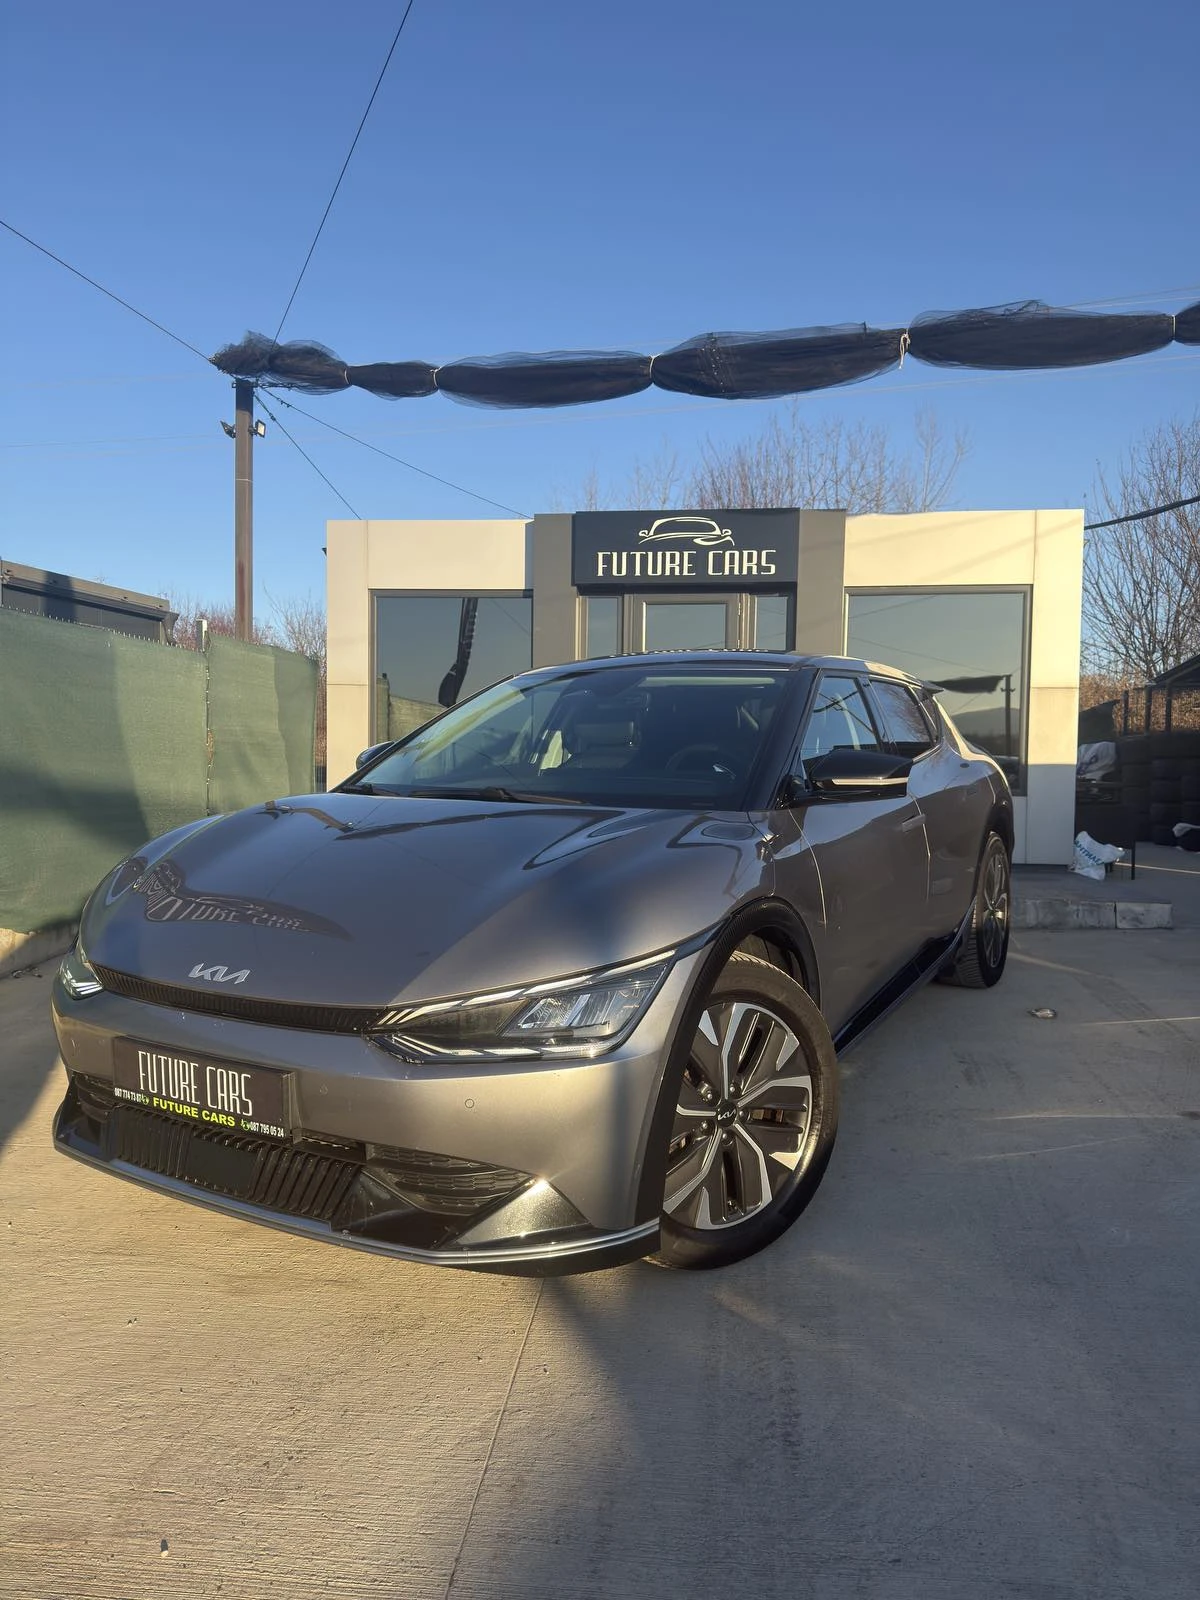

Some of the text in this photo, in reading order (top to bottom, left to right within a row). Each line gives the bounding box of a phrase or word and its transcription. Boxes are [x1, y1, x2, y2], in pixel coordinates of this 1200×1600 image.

[597, 549, 776, 577] FUTURE CARS
[137, 1050, 253, 1116] FUTURE CARS
[153, 1096, 236, 1127] FUTURE CARS
[260, 1123, 269, 1134] 795
[277, 1127, 284, 1138] 24
